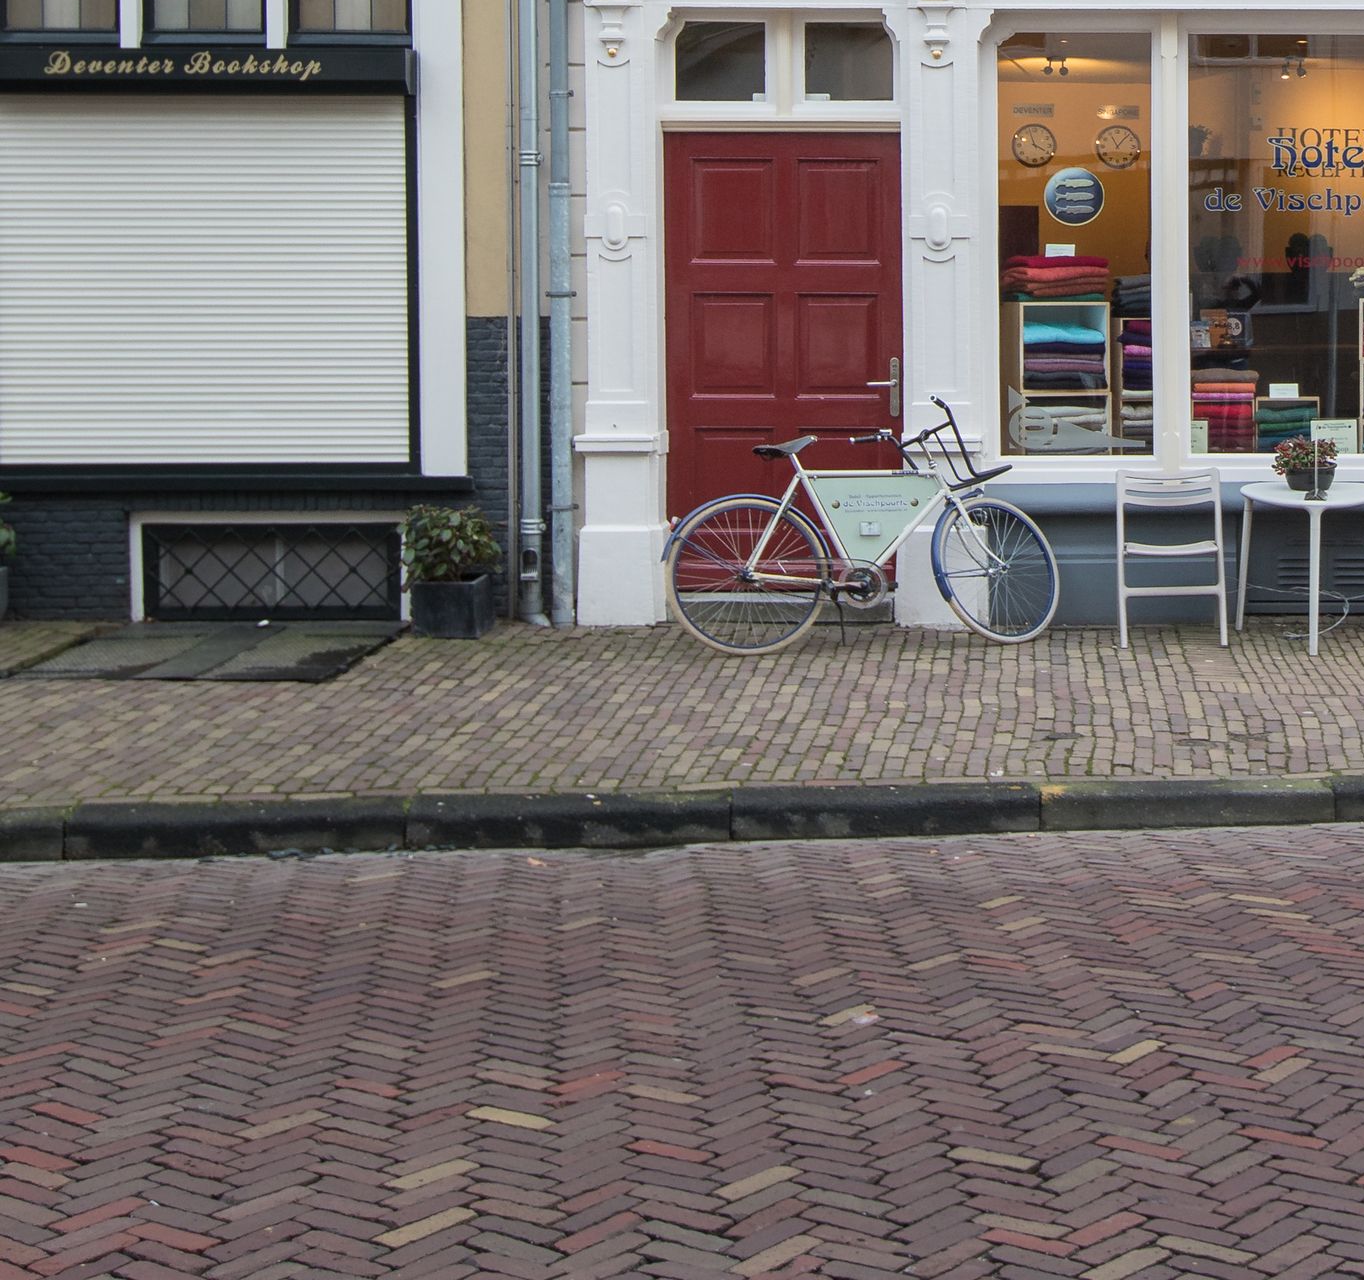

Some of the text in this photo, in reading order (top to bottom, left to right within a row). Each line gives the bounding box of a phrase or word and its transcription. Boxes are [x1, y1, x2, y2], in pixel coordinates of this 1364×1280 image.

[43, 50, 322, 81] Deventer Bookshop
[1013, 105, 1053, 115] DEVENTER
[1204, 187, 1243, 212] de
